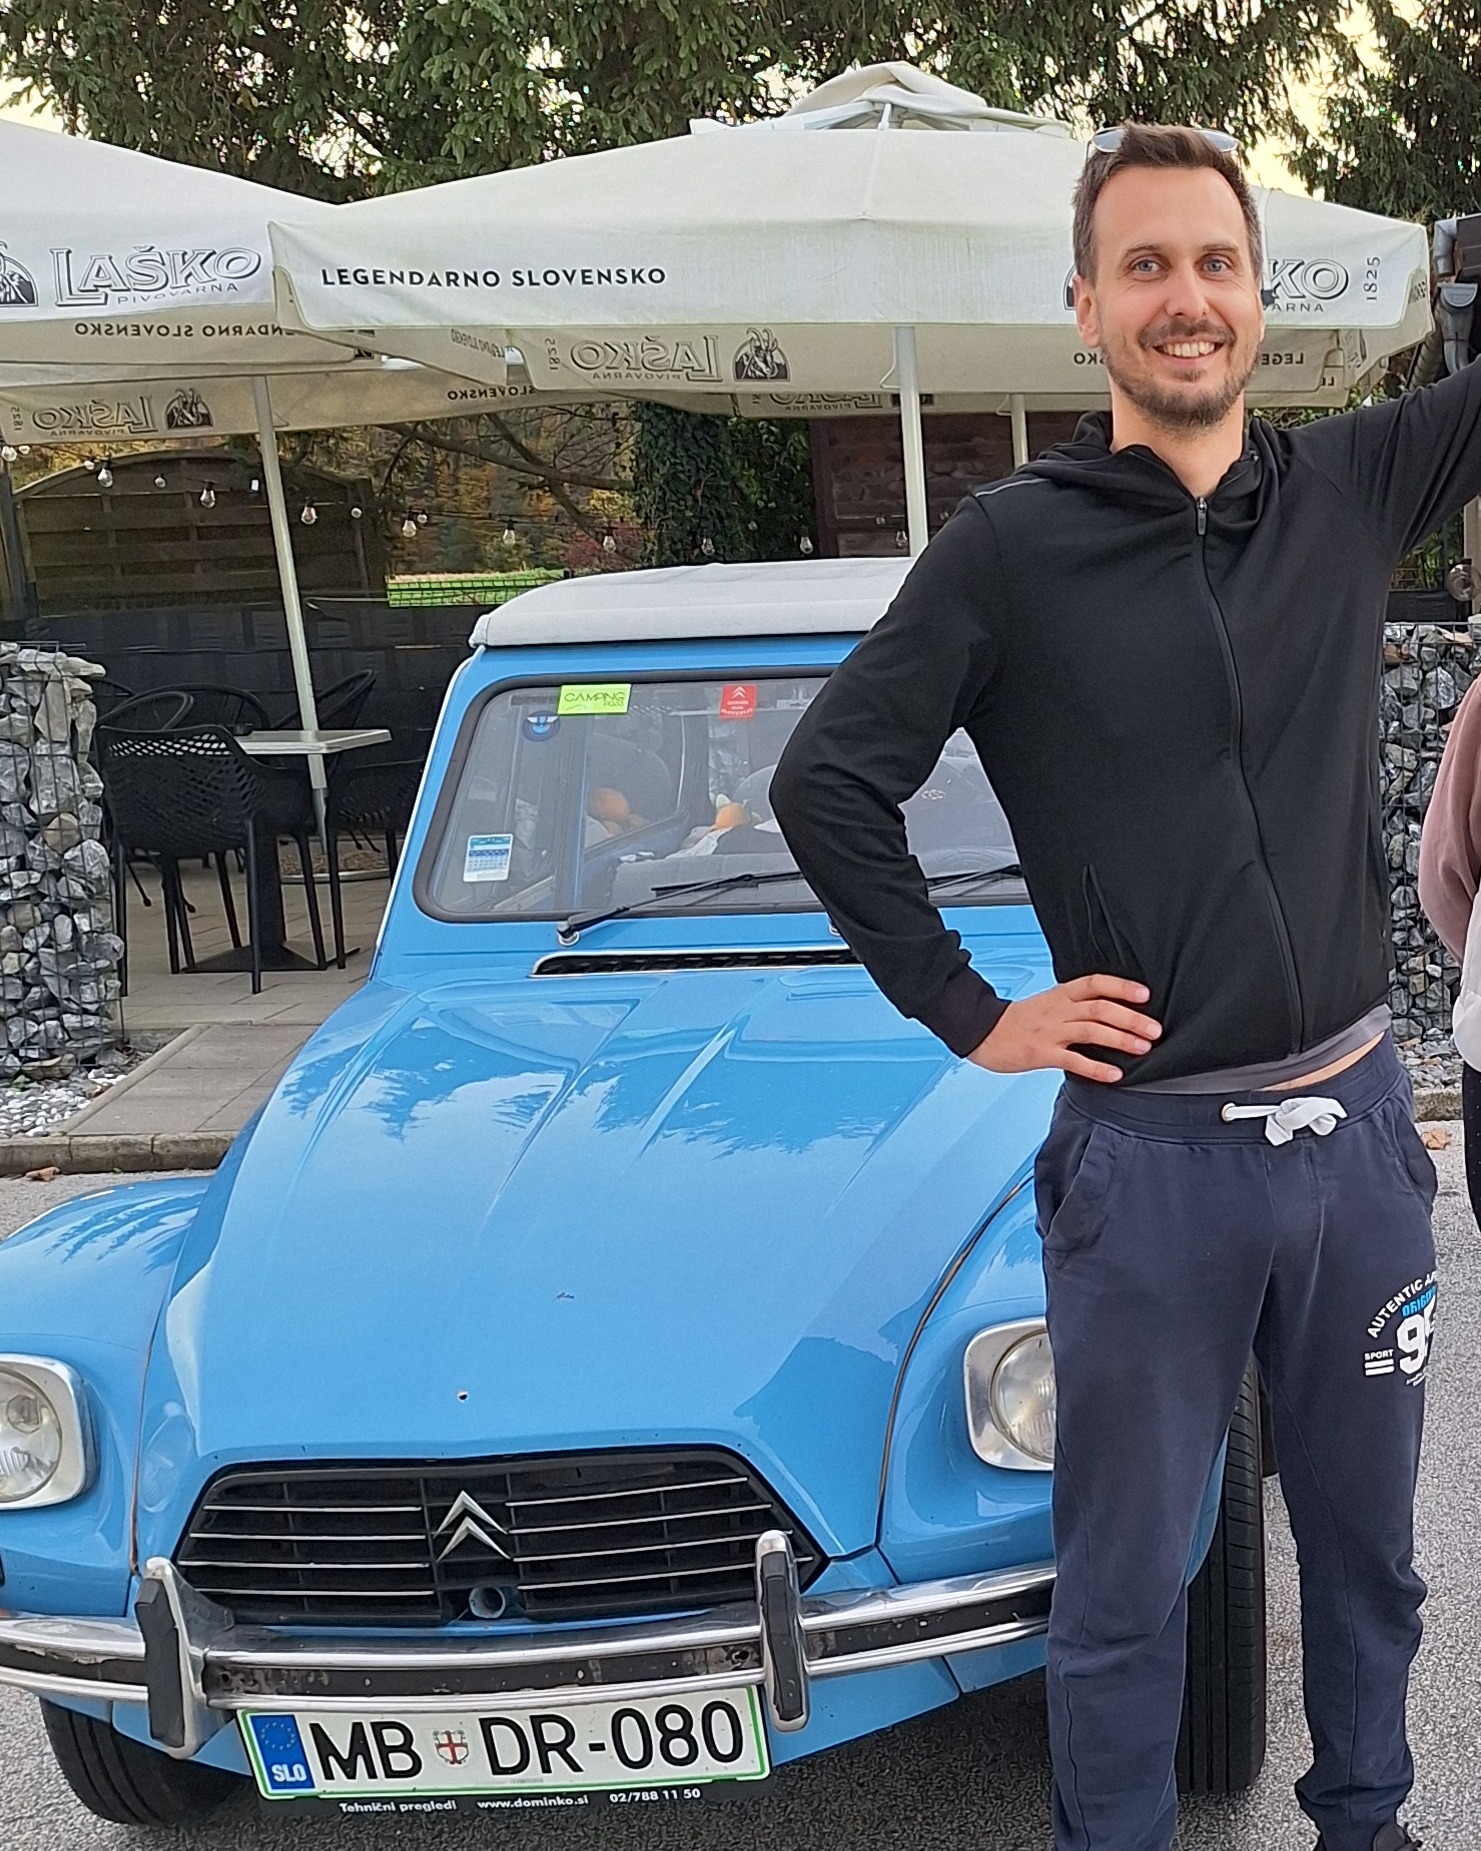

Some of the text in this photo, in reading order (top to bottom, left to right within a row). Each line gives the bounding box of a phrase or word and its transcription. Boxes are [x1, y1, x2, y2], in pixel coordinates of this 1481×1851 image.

[50, 245, 261, 307] LAŠKO
[321, 268, 666, 288] LEGENDARNO SLOVENSKO
[1363, 256, 1381, 301] 1825
[118, 282, 239, 304] PIVOVARNA
[1367, 1279, 1423, 1338] AUTENTIC
[1364, 1349, 1394, 1360] SPORT
[309, 1700, 744, 1780] MB DR-080
[271, 1763, 307, 1783] SLO
[339, 1788, 700, 1813] Tehnični pregledi www.dominko.si 02/788 11 50
